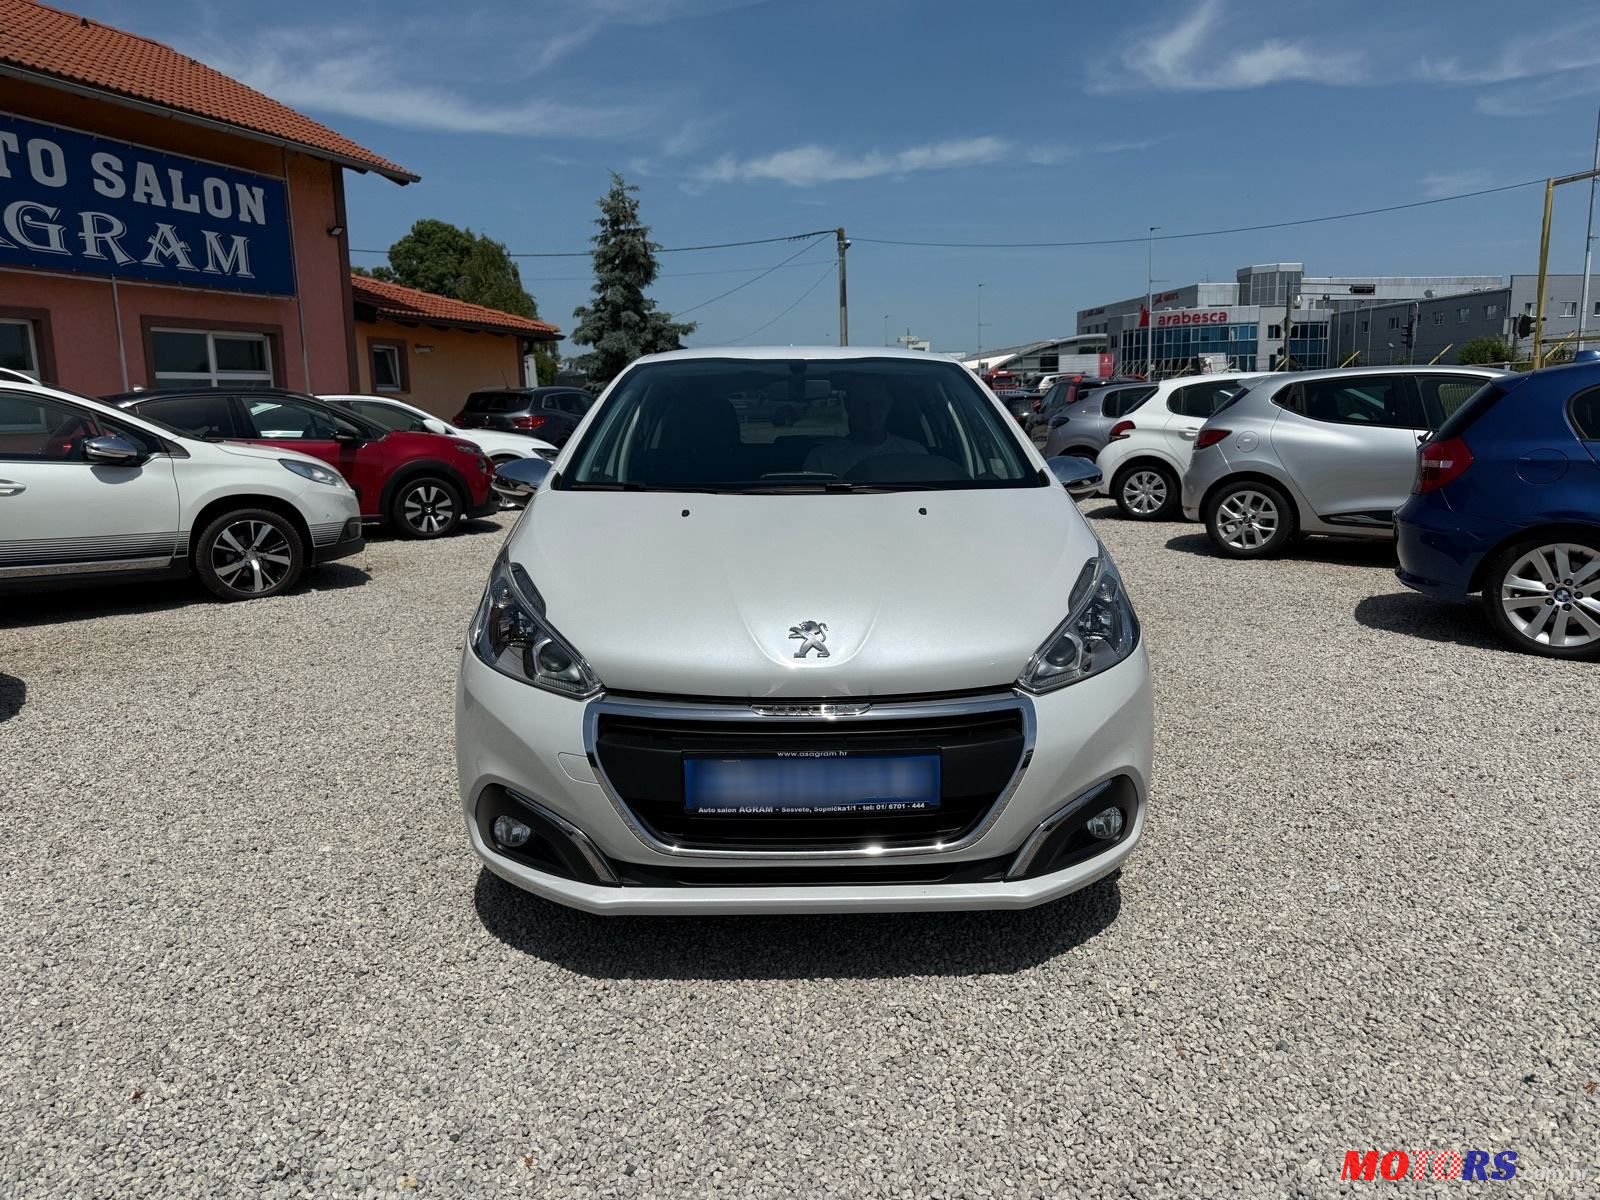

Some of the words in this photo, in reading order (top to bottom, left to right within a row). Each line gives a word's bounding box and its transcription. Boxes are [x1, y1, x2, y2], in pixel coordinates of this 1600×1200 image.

[90, 152, 267, 226] SALON
[0, 200, 256, 279] GRAM
[1158, 310, 1228, 327] arabesca
[777, 750, 848, 758] www.asagram.hr
